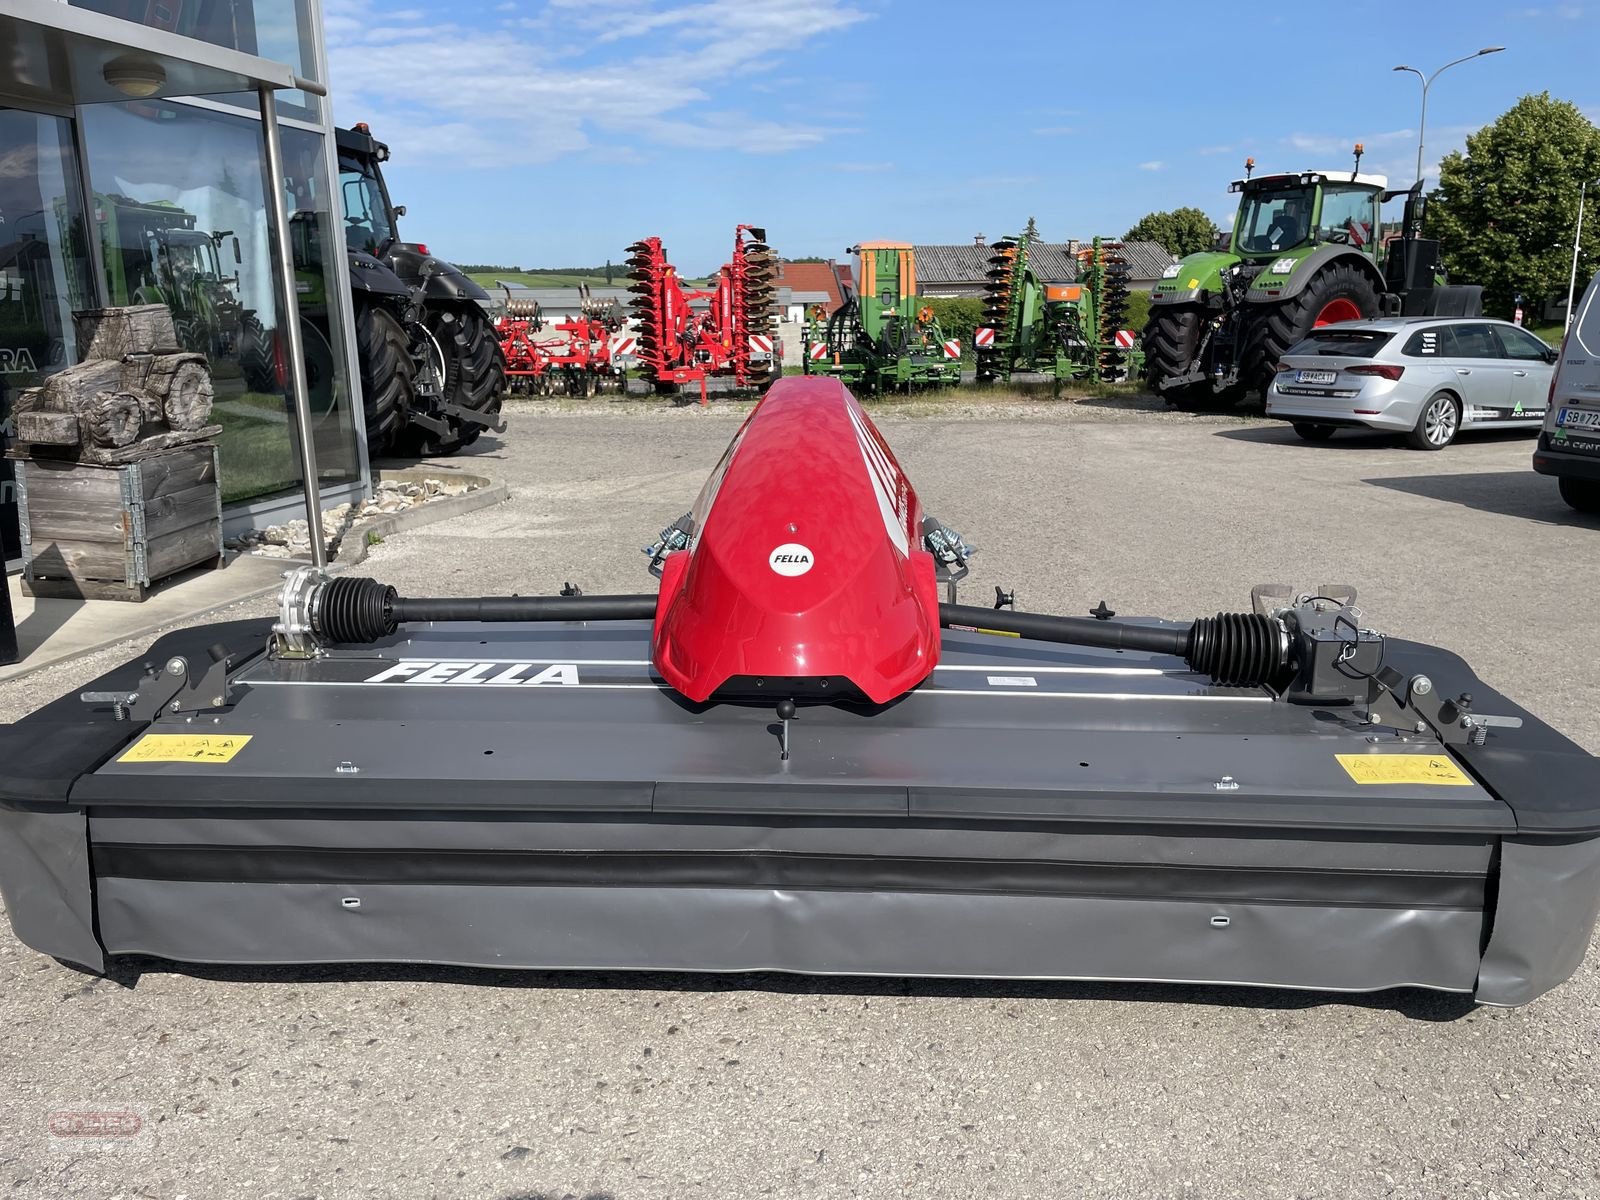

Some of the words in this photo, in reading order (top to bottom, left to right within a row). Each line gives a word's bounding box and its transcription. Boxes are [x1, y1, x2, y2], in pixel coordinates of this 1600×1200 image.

[1566, 411, 1579, 423] SB
[1550, 438, 1570, 447] ACA
[774, 554, 809, 563] FELLA
[363, 662, 580, 685] FELLA
